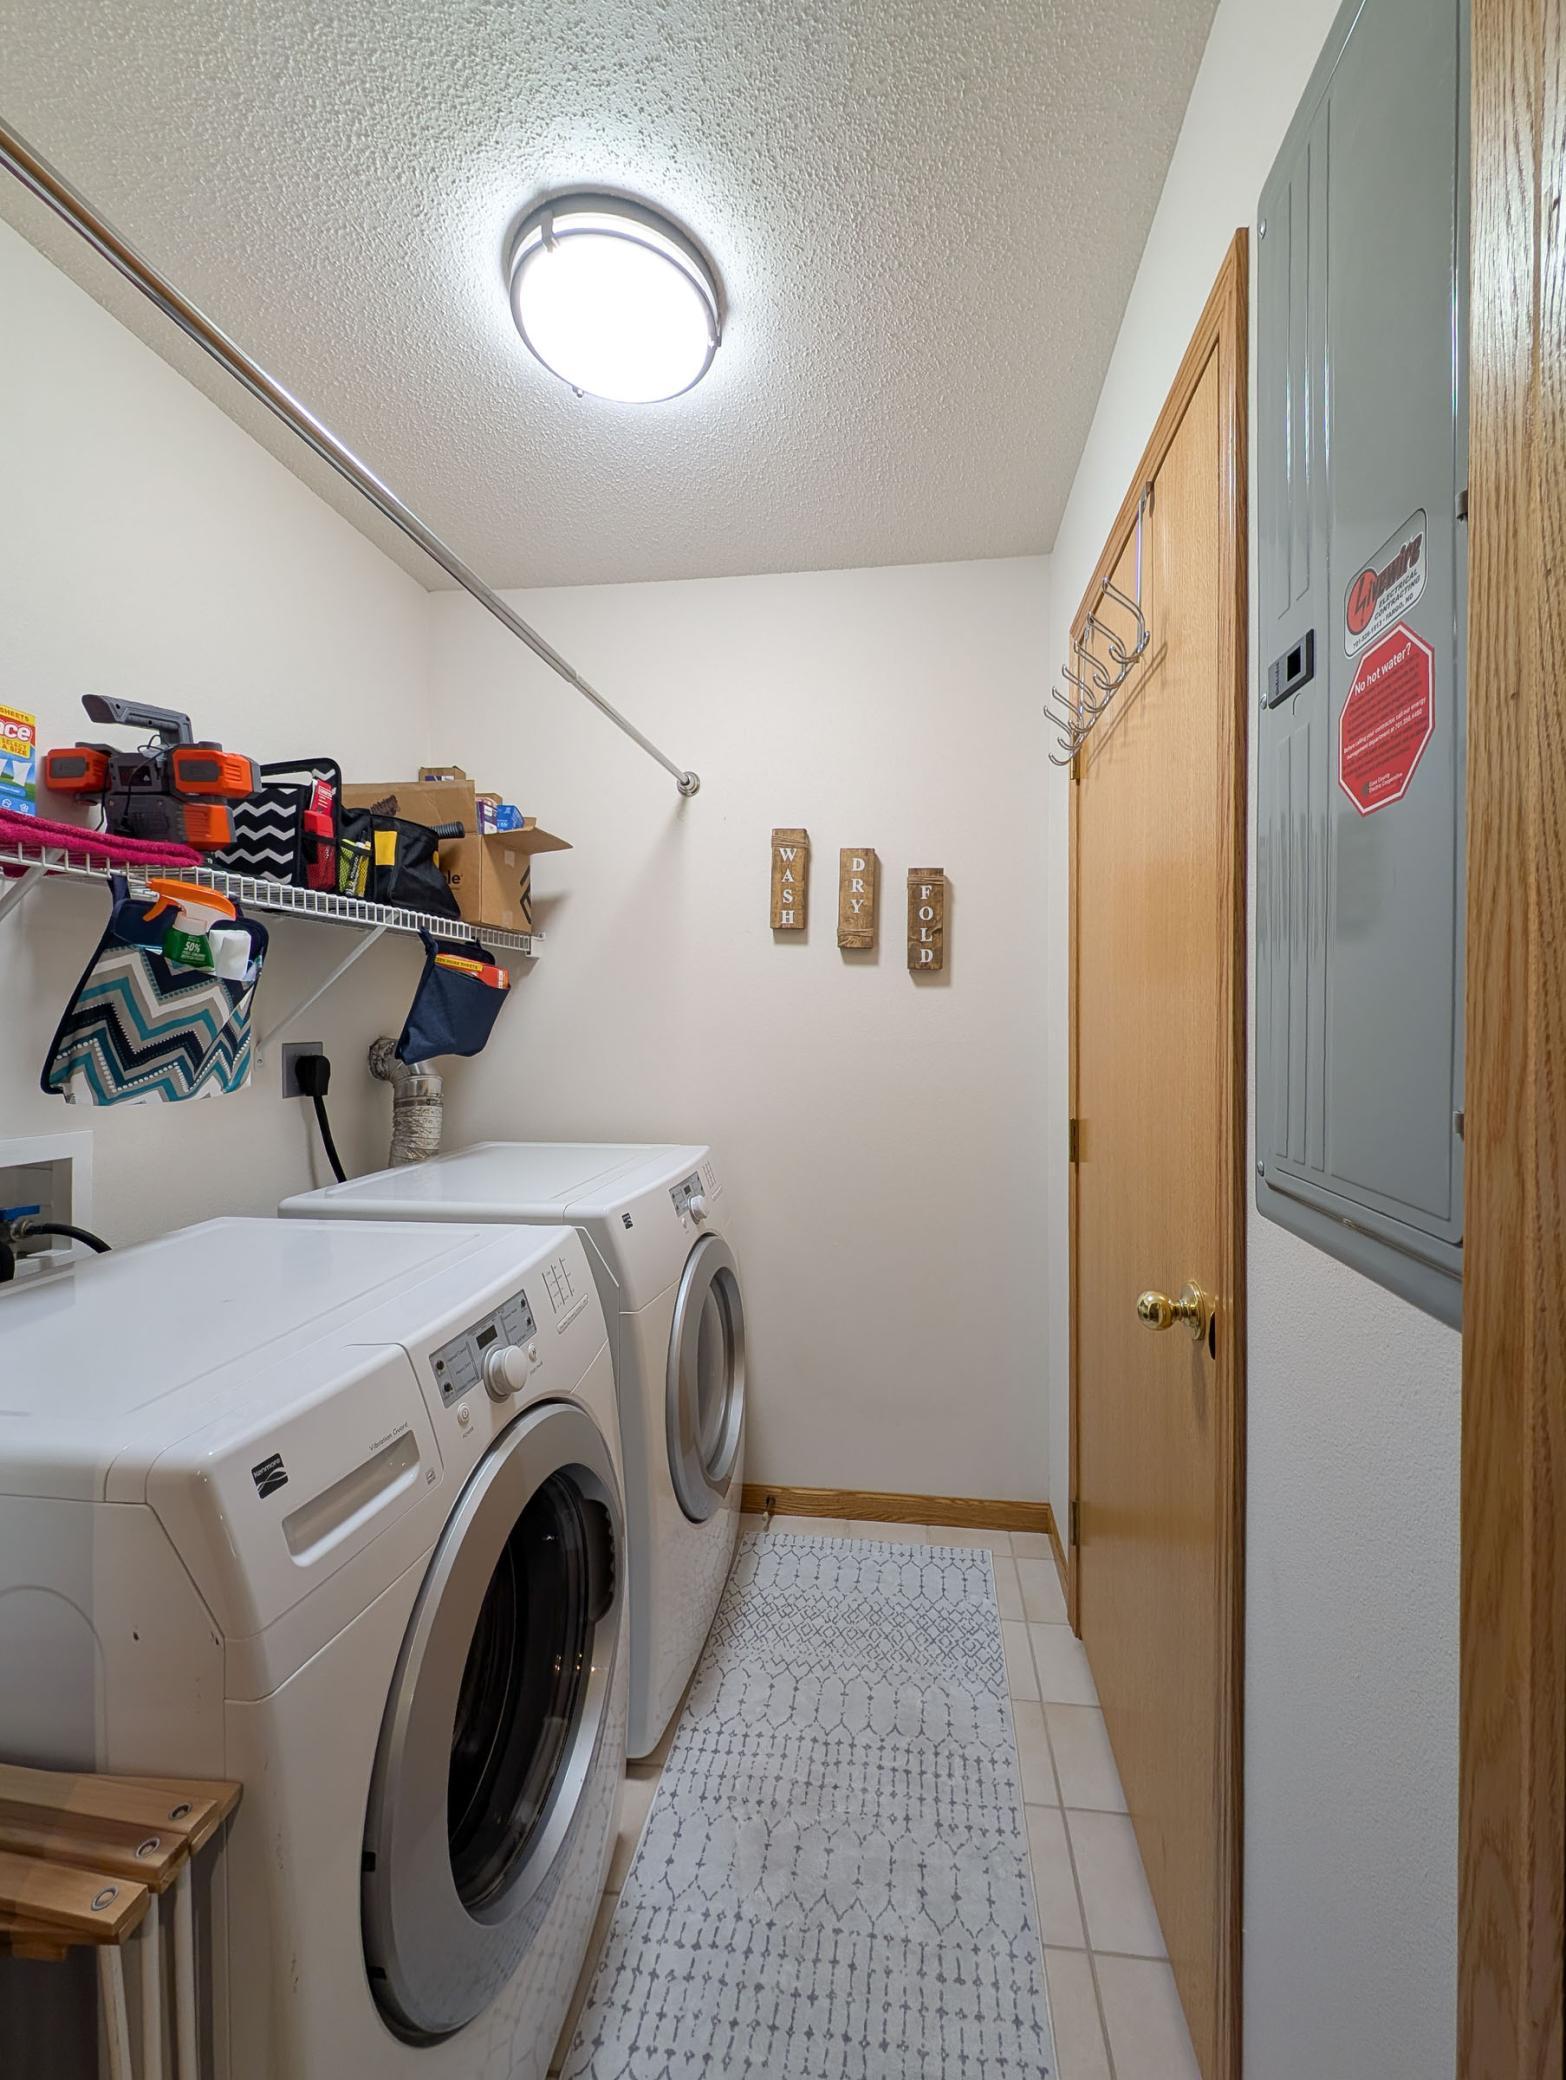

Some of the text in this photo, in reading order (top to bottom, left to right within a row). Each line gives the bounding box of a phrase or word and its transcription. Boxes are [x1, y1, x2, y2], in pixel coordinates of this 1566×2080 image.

[1374, 574, 1421, 620] CONTRACTING
[1378, 569, 1418, 608] ELECTRICAL
[1354, 641, 1412, 696] No hot water?
[779, 847, 797, 924] WASH
[850, 857, 865, 914] DRY
[184, 941, 200, 953] 50%
[918, 885, 934, 963] FOLD
